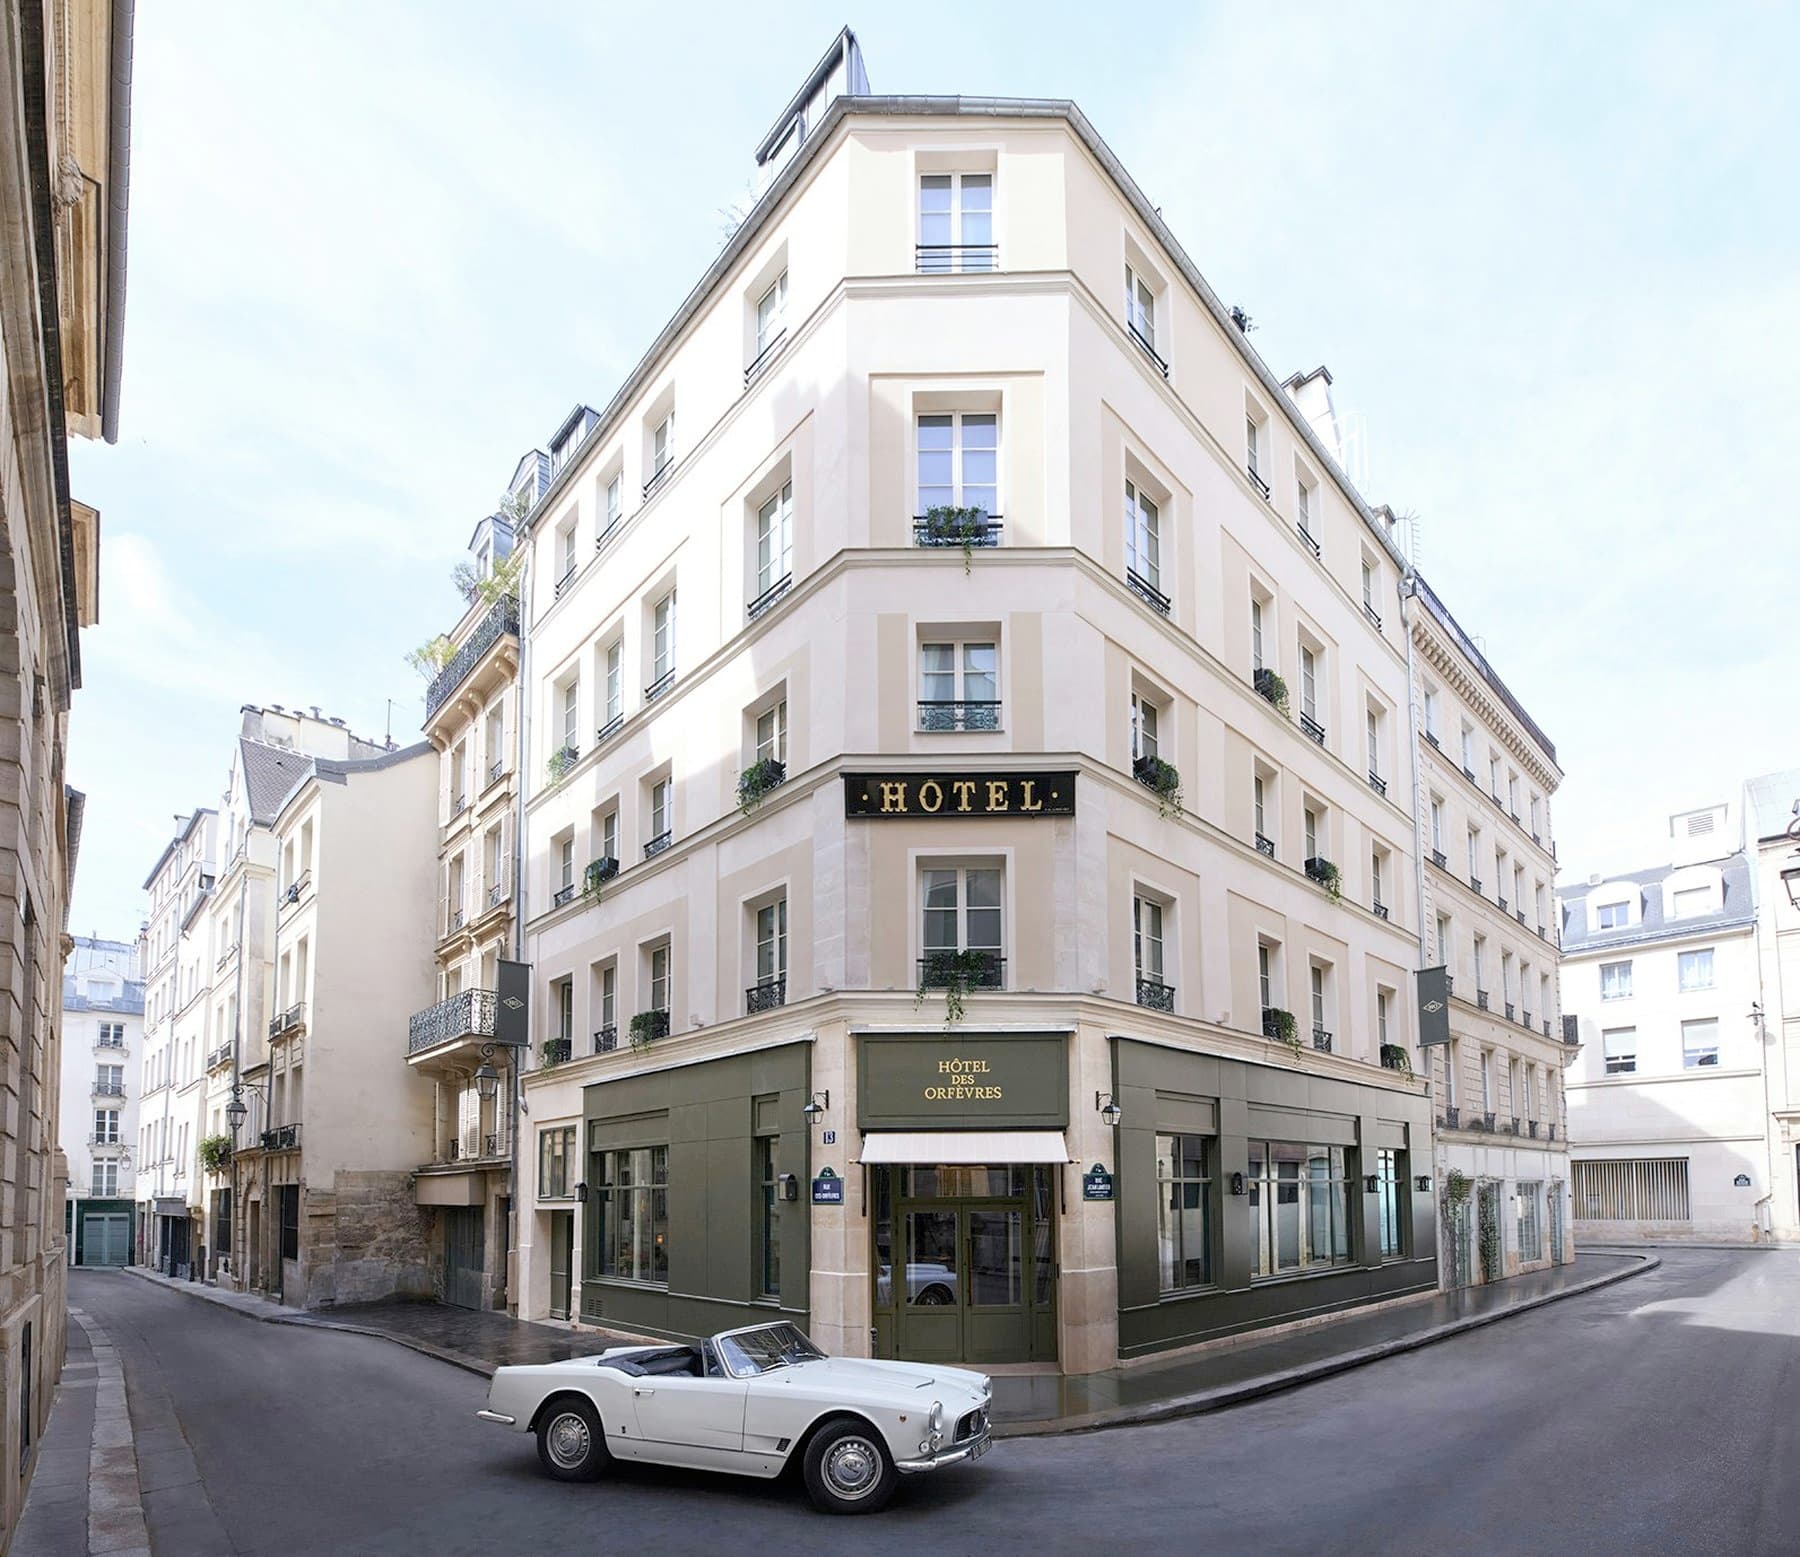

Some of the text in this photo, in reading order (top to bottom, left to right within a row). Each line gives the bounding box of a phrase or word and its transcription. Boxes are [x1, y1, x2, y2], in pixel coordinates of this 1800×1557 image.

[938, 1058, 990, 1073] HÔTEL
[951, 1074, 975, 1085] DES
[924, 1085, 1002, 1099] ORFÈVRES
[825, 1131, 834, 1143] 13
